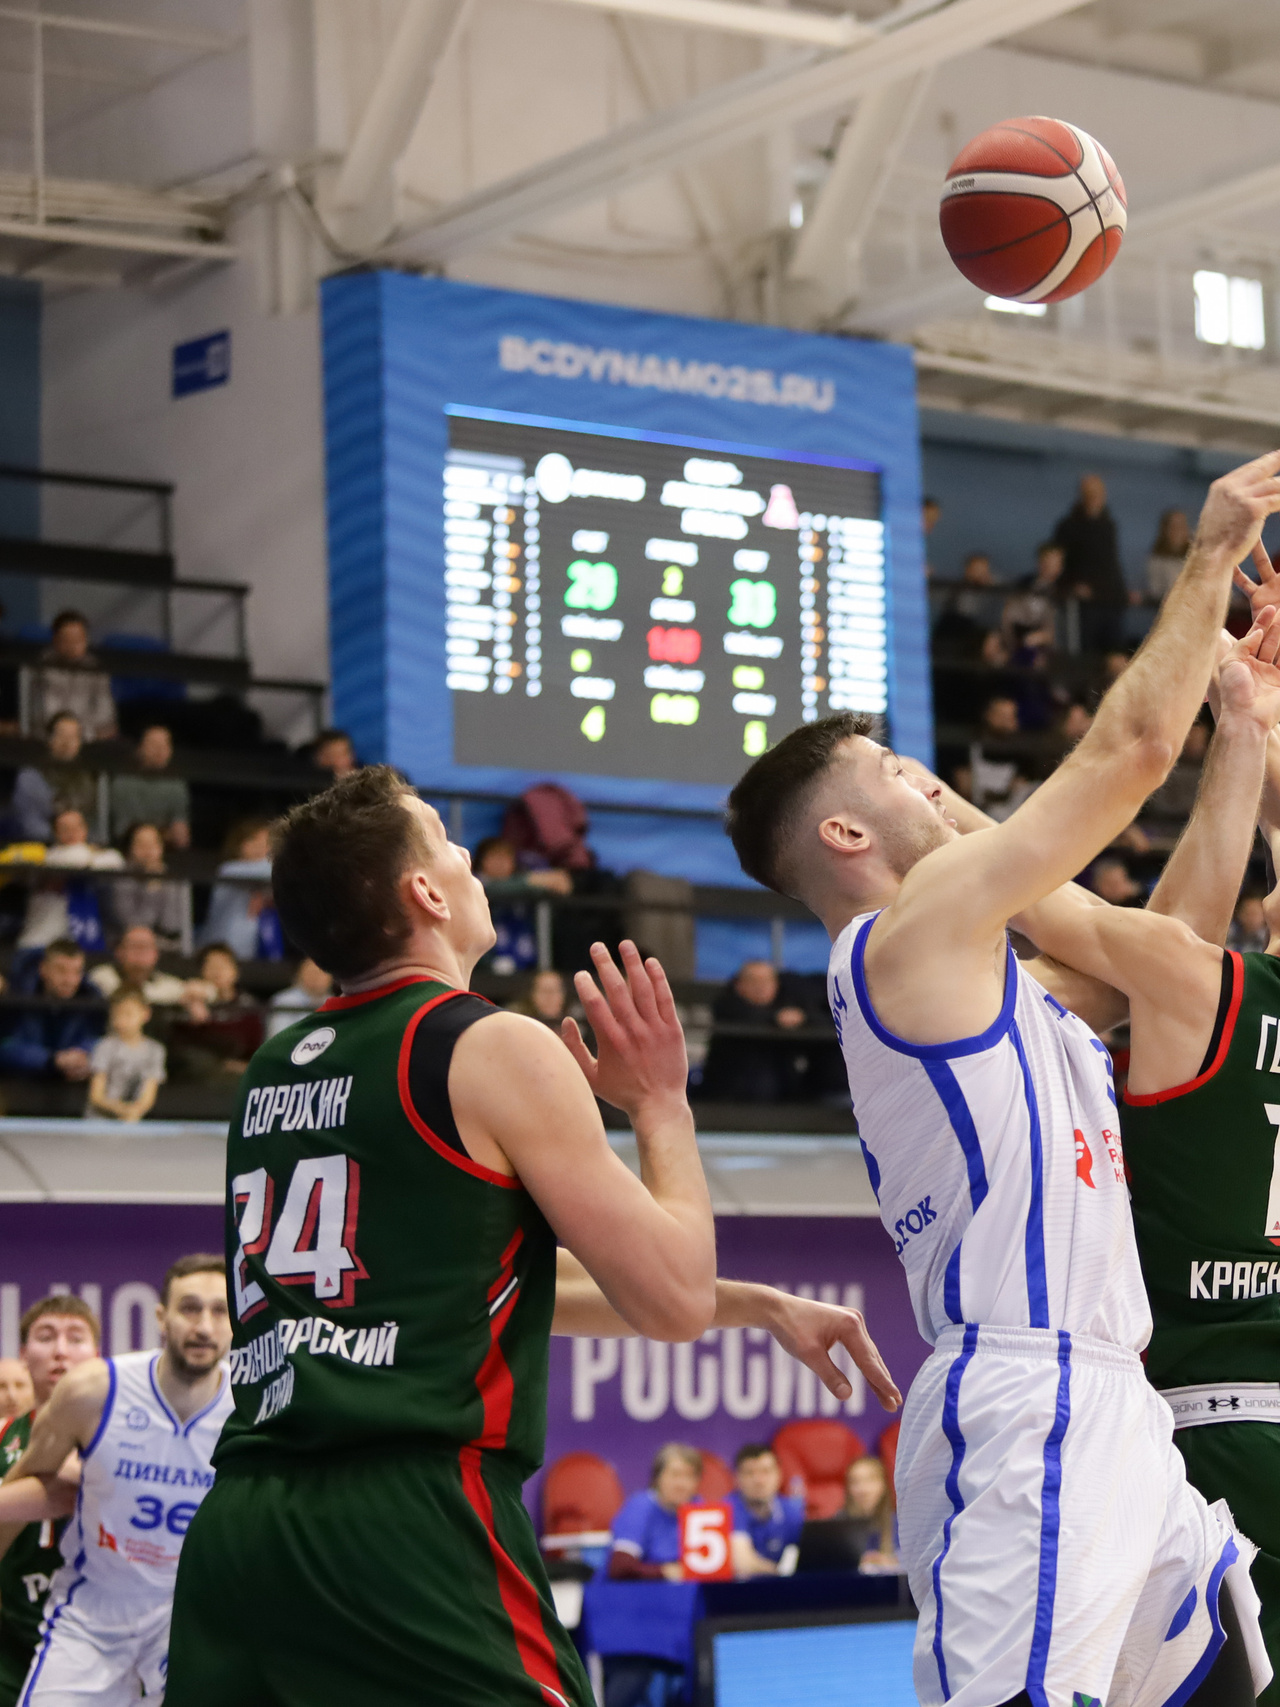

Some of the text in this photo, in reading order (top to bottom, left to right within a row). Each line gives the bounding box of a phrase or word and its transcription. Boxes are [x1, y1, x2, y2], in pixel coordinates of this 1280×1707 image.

[243, 1075, 353, 1138] СОРОКИН
[231, 1153, 368, 1323] 24
[230, 1316, 400, 1386] РАСНОДАРСКИЙ
[1172, 1401, 1203, 1414] UNDE
[113, 1457, 217, 1488] ДИНАМ
[129, 1494, 200, 1536] 36
[684, 1509, 728, 1575] 5
